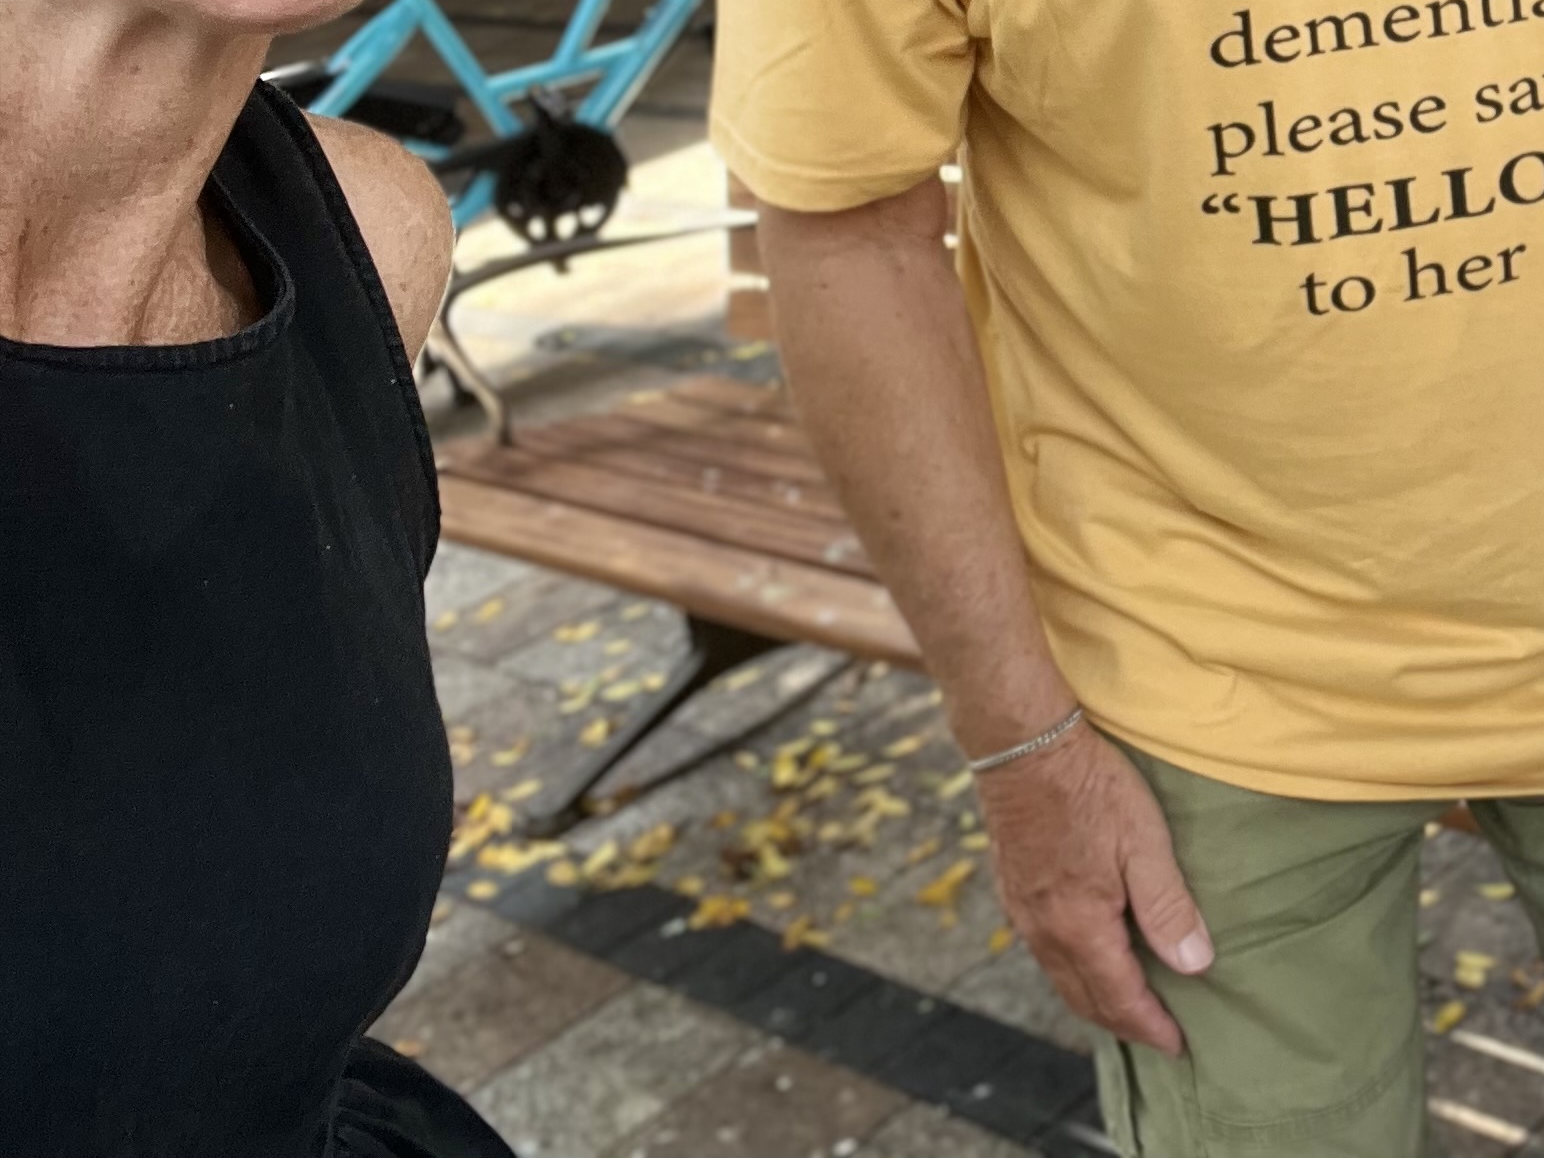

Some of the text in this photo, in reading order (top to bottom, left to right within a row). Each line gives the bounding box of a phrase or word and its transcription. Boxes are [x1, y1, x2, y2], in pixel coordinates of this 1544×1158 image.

[1205, 94, 1448, 178] please
[1299, 243, 1527, 316] to her
